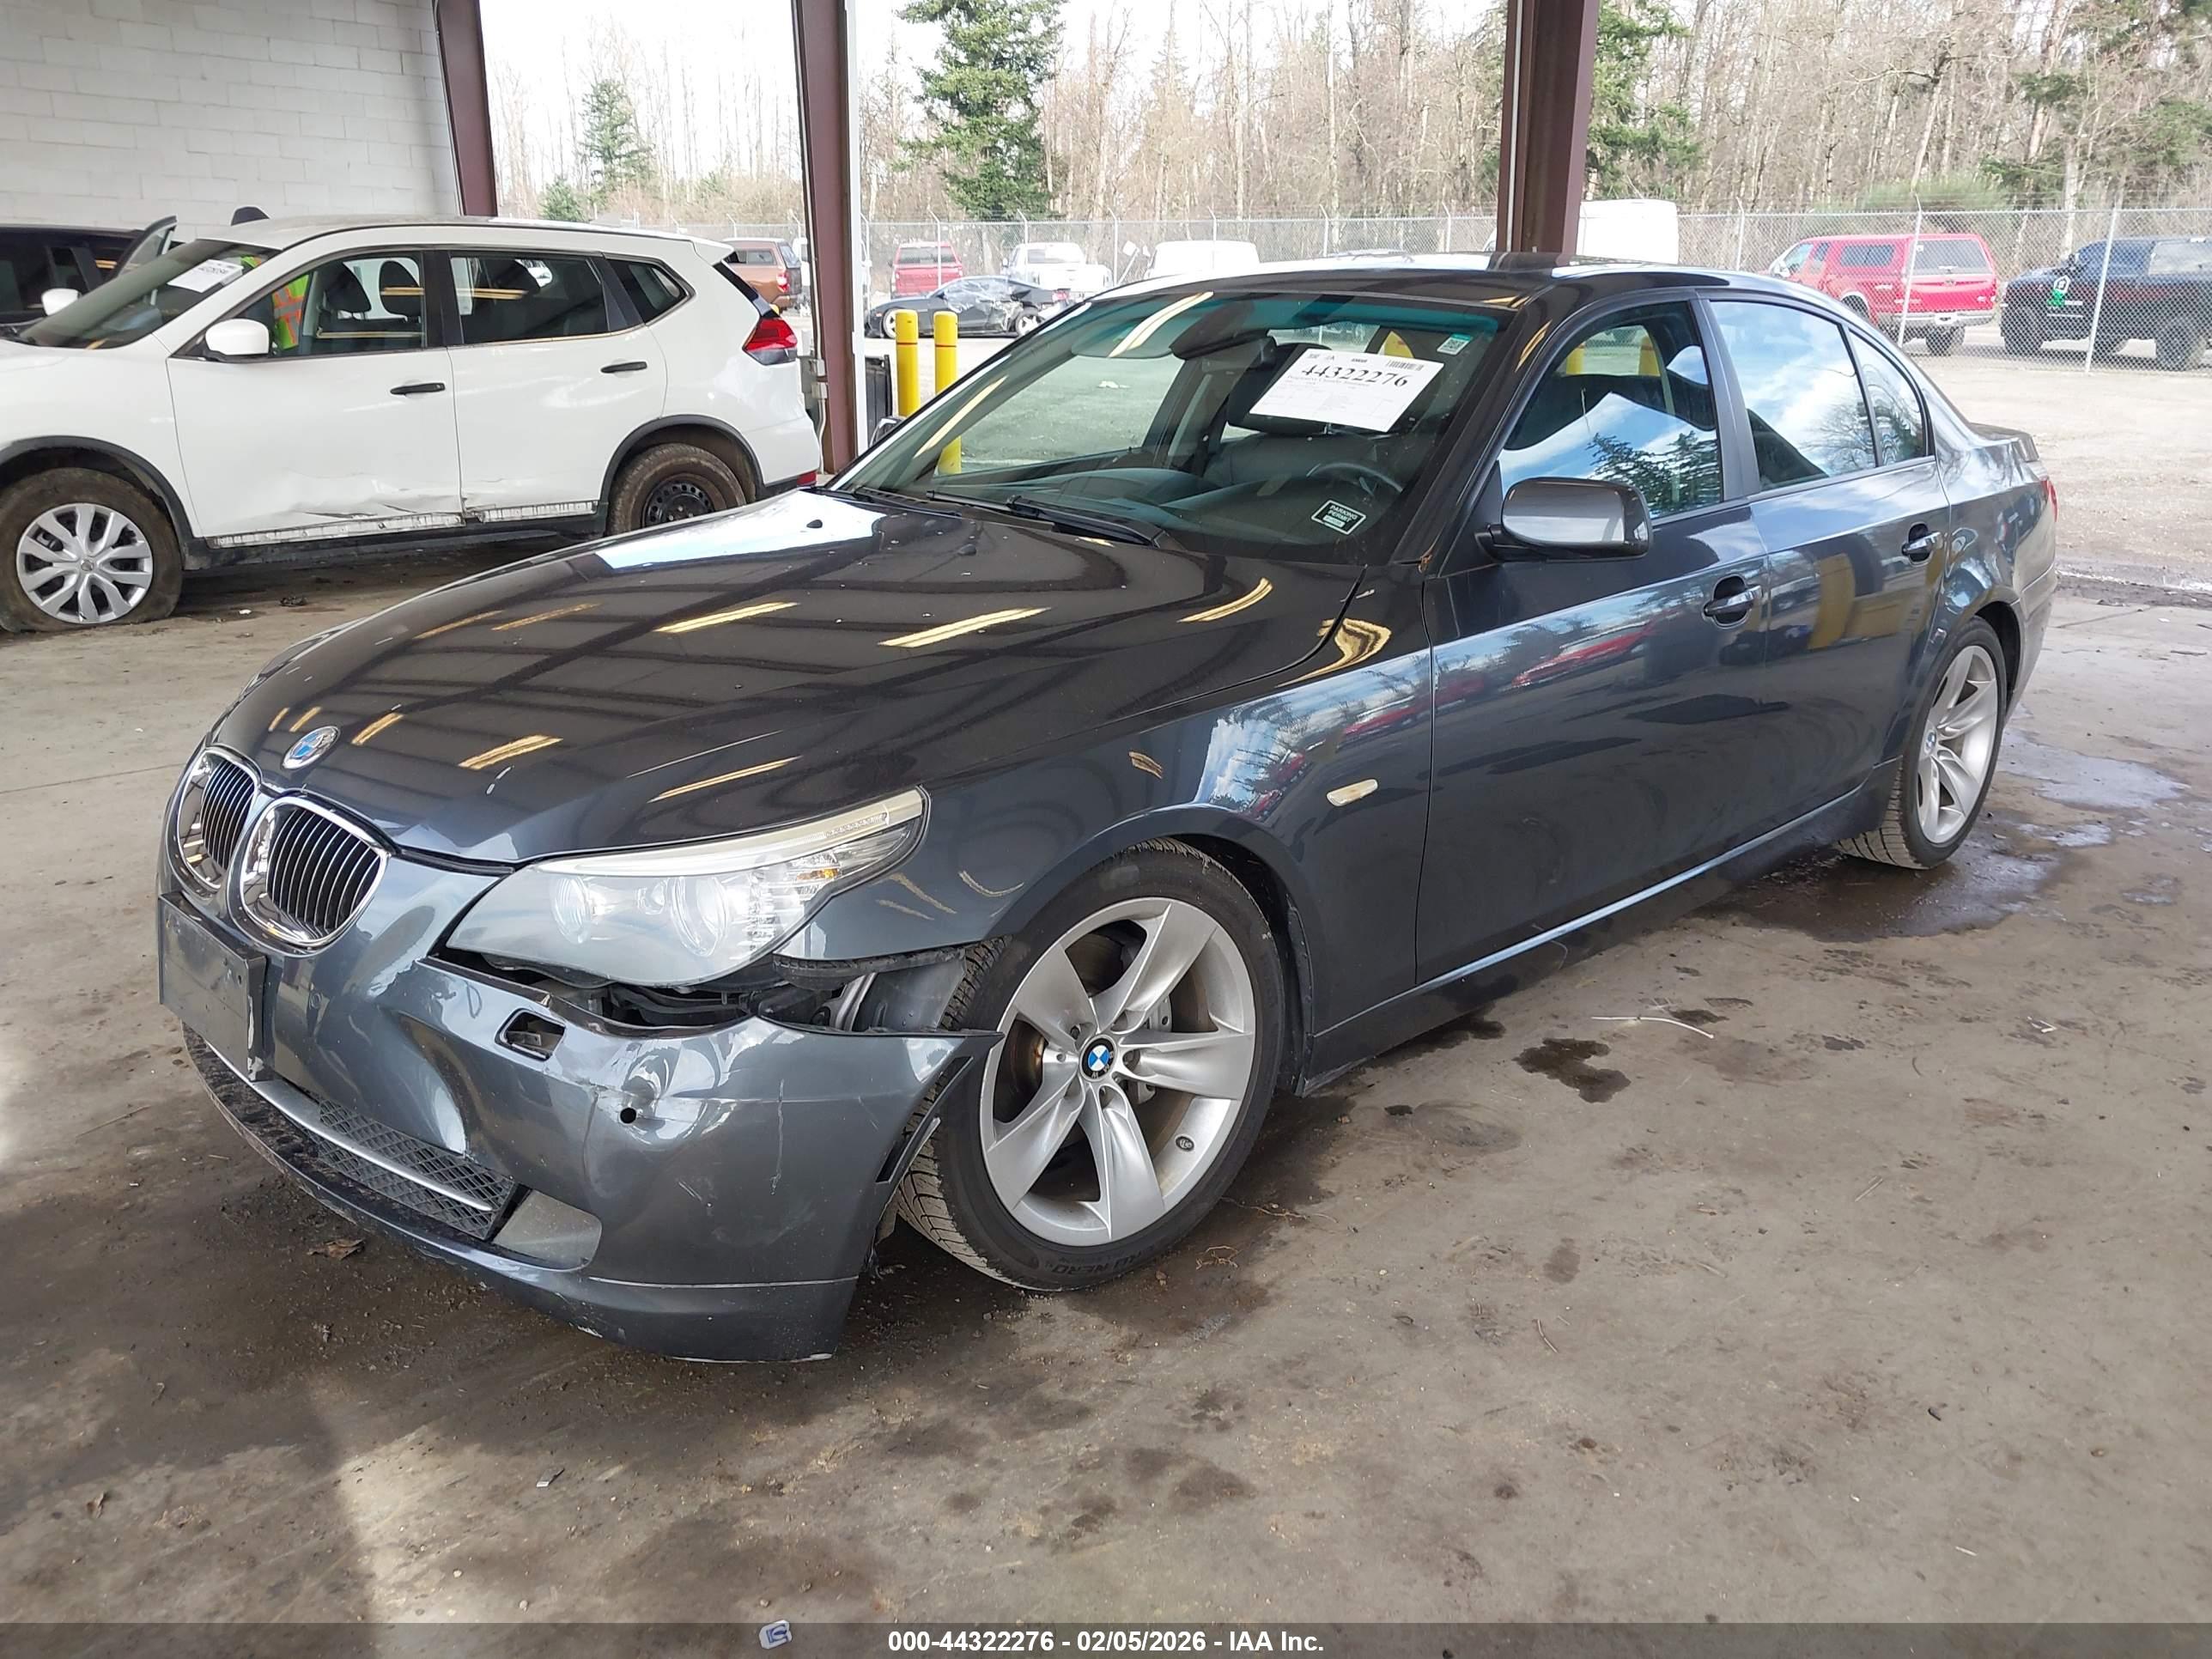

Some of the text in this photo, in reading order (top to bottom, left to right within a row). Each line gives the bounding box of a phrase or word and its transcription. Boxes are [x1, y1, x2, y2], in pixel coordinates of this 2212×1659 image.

[1302, 364, 1412, 386] 44322276
[1328, 510, 1352, 522] PERMIT
[1329, 505, 1358, 520] PARKING
